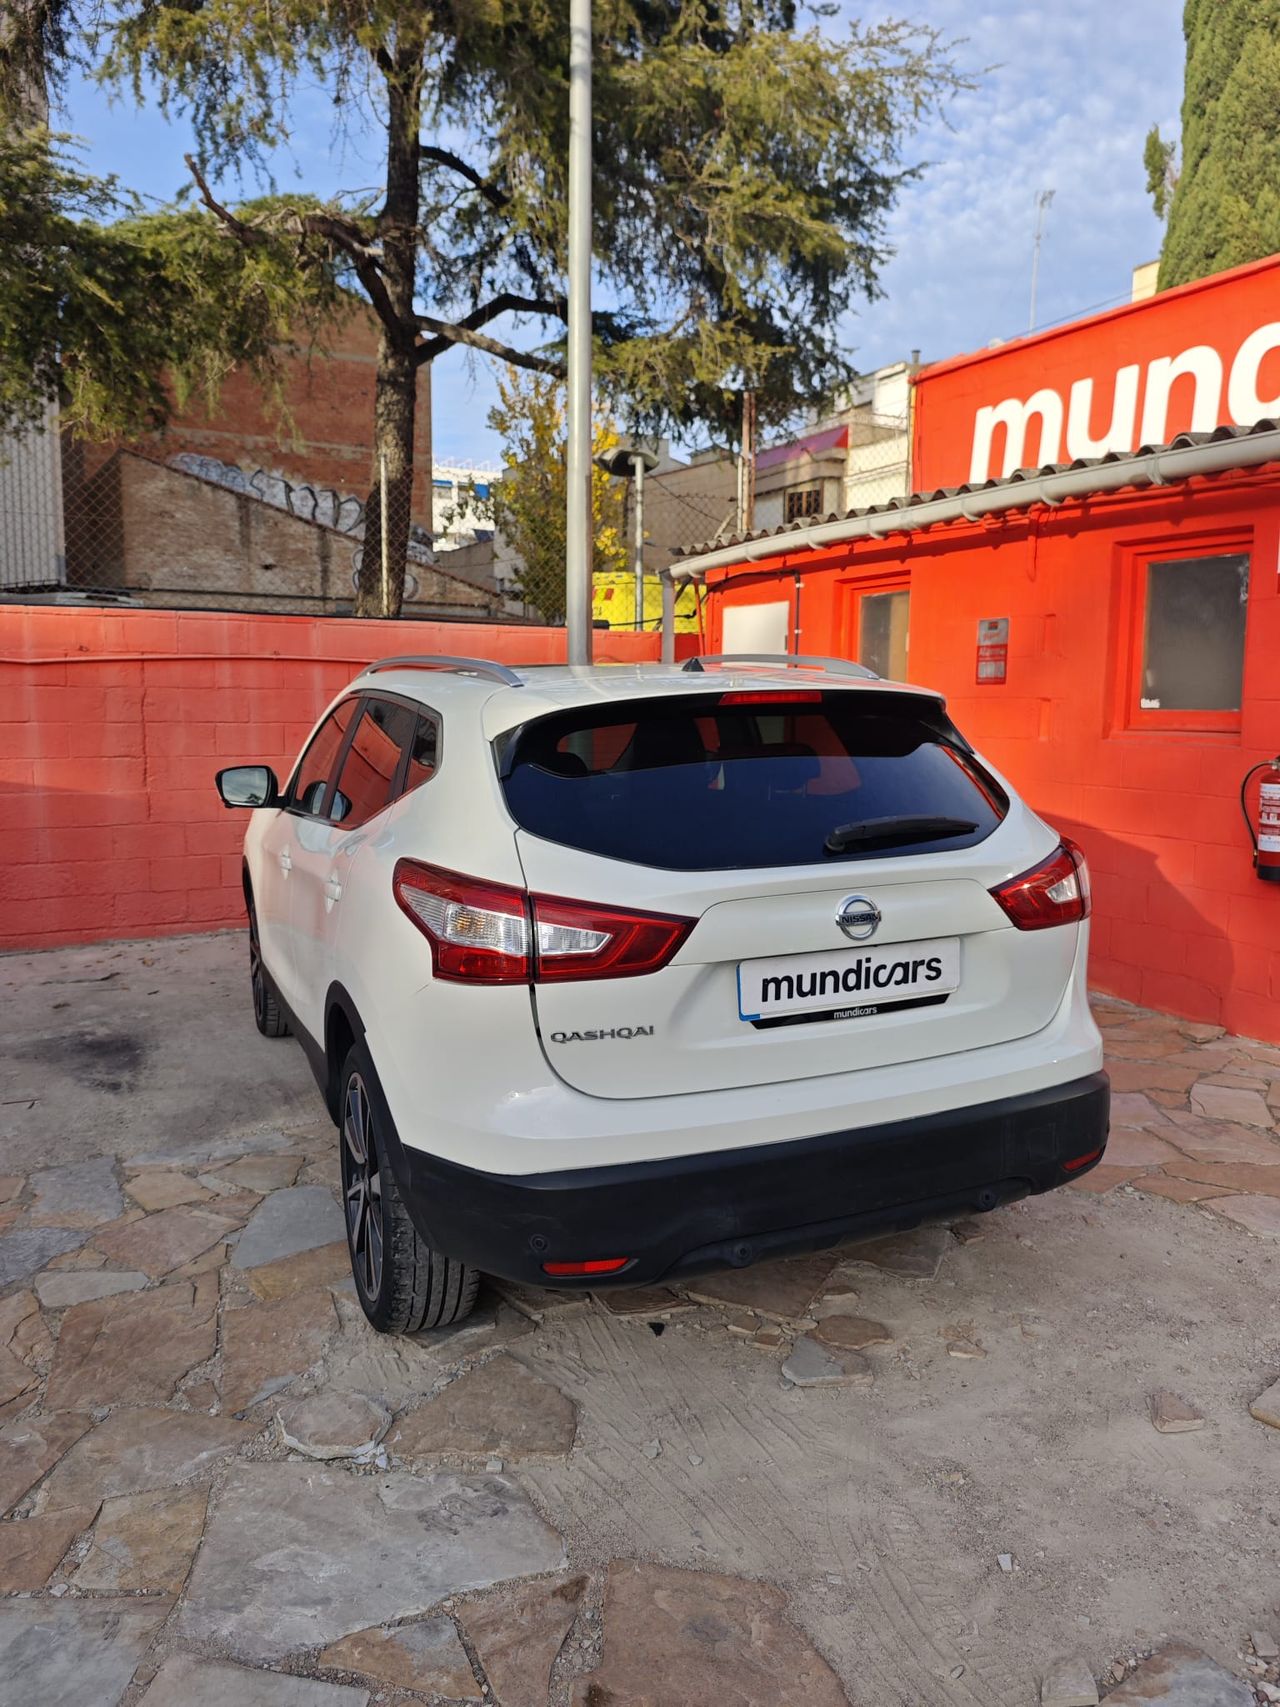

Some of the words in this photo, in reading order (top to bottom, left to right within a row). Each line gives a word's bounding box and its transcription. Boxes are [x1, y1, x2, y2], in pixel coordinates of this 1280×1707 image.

[841, 912, 879, 924] NISSAN
[761, 957, 942, 1002] mundicars
[834, 1006, 878, 1020] mundicars
[550, 1025, 654, 1044] QASHQAI
